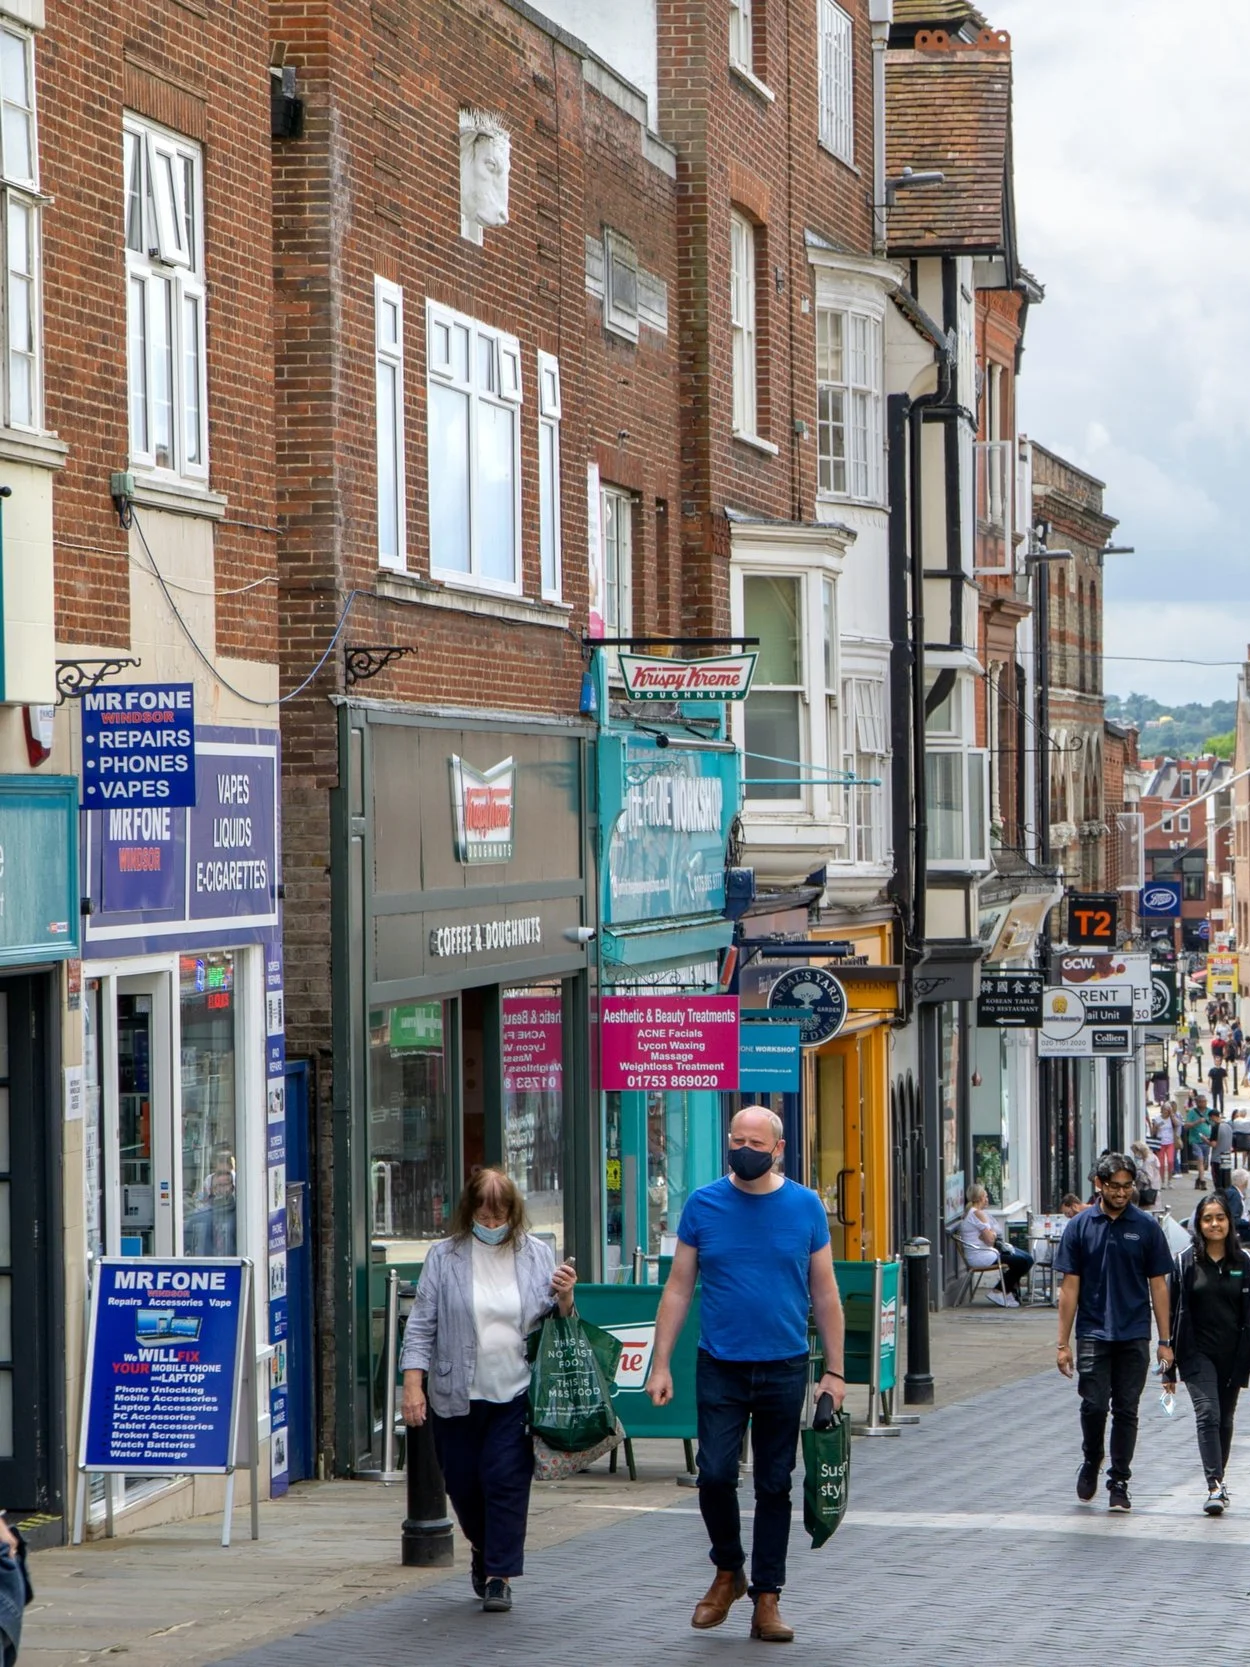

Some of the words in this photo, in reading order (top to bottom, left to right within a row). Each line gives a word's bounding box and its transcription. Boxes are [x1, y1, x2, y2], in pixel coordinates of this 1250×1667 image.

[632, 666, 688, 690] Krispy
[686, 666, 743, 688] Kreme
[634, 691, 738, 699] DOUGHNUTS
[101, 711, 174, 724] WINDSOR
[99, 729, 191, 748] REPAIRS
[100, 755, 188, 774] PHONES
[100, 780, 170, 799] VAPES
[217, 774, 249, 804] VAPES
[671, 776, 723, 832] WORKSHOP
[213, 817, 252, 848] LIQUIDS
[468, 844, 512, 858] DOUGHNUTS
[119, 847, 161, 872] WINDSOR
[196, 860, 266, 892] E-CIGARETTES
[1074, 910, 1112, 936] T2
[437, 926, 472, 957] COFFEE
[475, 924, 483, 951] &
[485, 916, 541, 950] DOUGHNUTS
[1062, 957, 1095, 970] GCW.
[774, 971, 812, 1002] NEAL'S
[815, 974, 841, 1004] YARD
[1080, 989, 1118, 1002] RENT
[1133, 988, 1149, 1000] ET
[603, 1009, 644, 1023] Aesthetic
[646, 1009, 653, 1023] &
[656, 1009, 685, 1026] Beauty
[687, 1008, 736, 1023] Treatments
[1087, 1010, 1098, 1020] ail
[1100, 1010, 1120, 1020] Unit
[637, 1029, 666, 1038] ACNE
[668, 1029, 703, 1038] Facials
[1094, 1033, 1125, 1042] Colliers
[638, 1041, 667, 1052] Lycon
[669, 1041, 706, 1052] Waxing
[739, 1044, 754, 1052] ONE
[651, 1052, 693, 1062] Massage
[619, 1062, 673, 1072] Weightloss
[675, 1062, 724, 1071] Treatment
[627, 1075, 667, 1087] 01753
[670, 1075, 718, 1087] 869020
[147, 1290, 190, 1298] WINDSOR
[108, 1297, 142, 1307] Repairs
[149, 1298, 203, 1307] Accessories
[209, 1298, 231, 1308] Vape
[553, 1338, 576, 1348] THIS
[124, 1353, 138, 1362] We
[138, 1349, 178, 1362] WILL
[177, 1351, 200, 1362] FIX
[112, 1362, 150, 1374] YOUR
[151, 1364, 187, 1373] MOBILE
[189, 1364, 222, 1373] PHONE
[161, 1374, 205, 1383] LAPTOP
[557, 1378, 578, 1388] THIS
[115, 1385, 148, 1393] Phone
[151, 1386, 204, 1395] Unlocking
[548, 1389, 570, 1399] M&S
[574, 1387, 601, 1397] FOOD
[114, 1394, 150, 1402] Mobile
[152, 1394, 218, 1403] Accessories
[113, 1403, 151, 1412] Laptop
[153, 1404, 219, 1412] Accessories
[130, 1413, 196, 1421] Accessories
[112, 1422, 146, 1430] Tablet
[149, 1422, 214, 1431] Accessories
[111, 1431, 149, 1439] Broken
[152, 1432, 196, 1440] Screens
[147, 1441, 196, 1449] Batteries
[110, 1450, 142, 1458] Water
[144, 1451, 188, 1460] Damage
